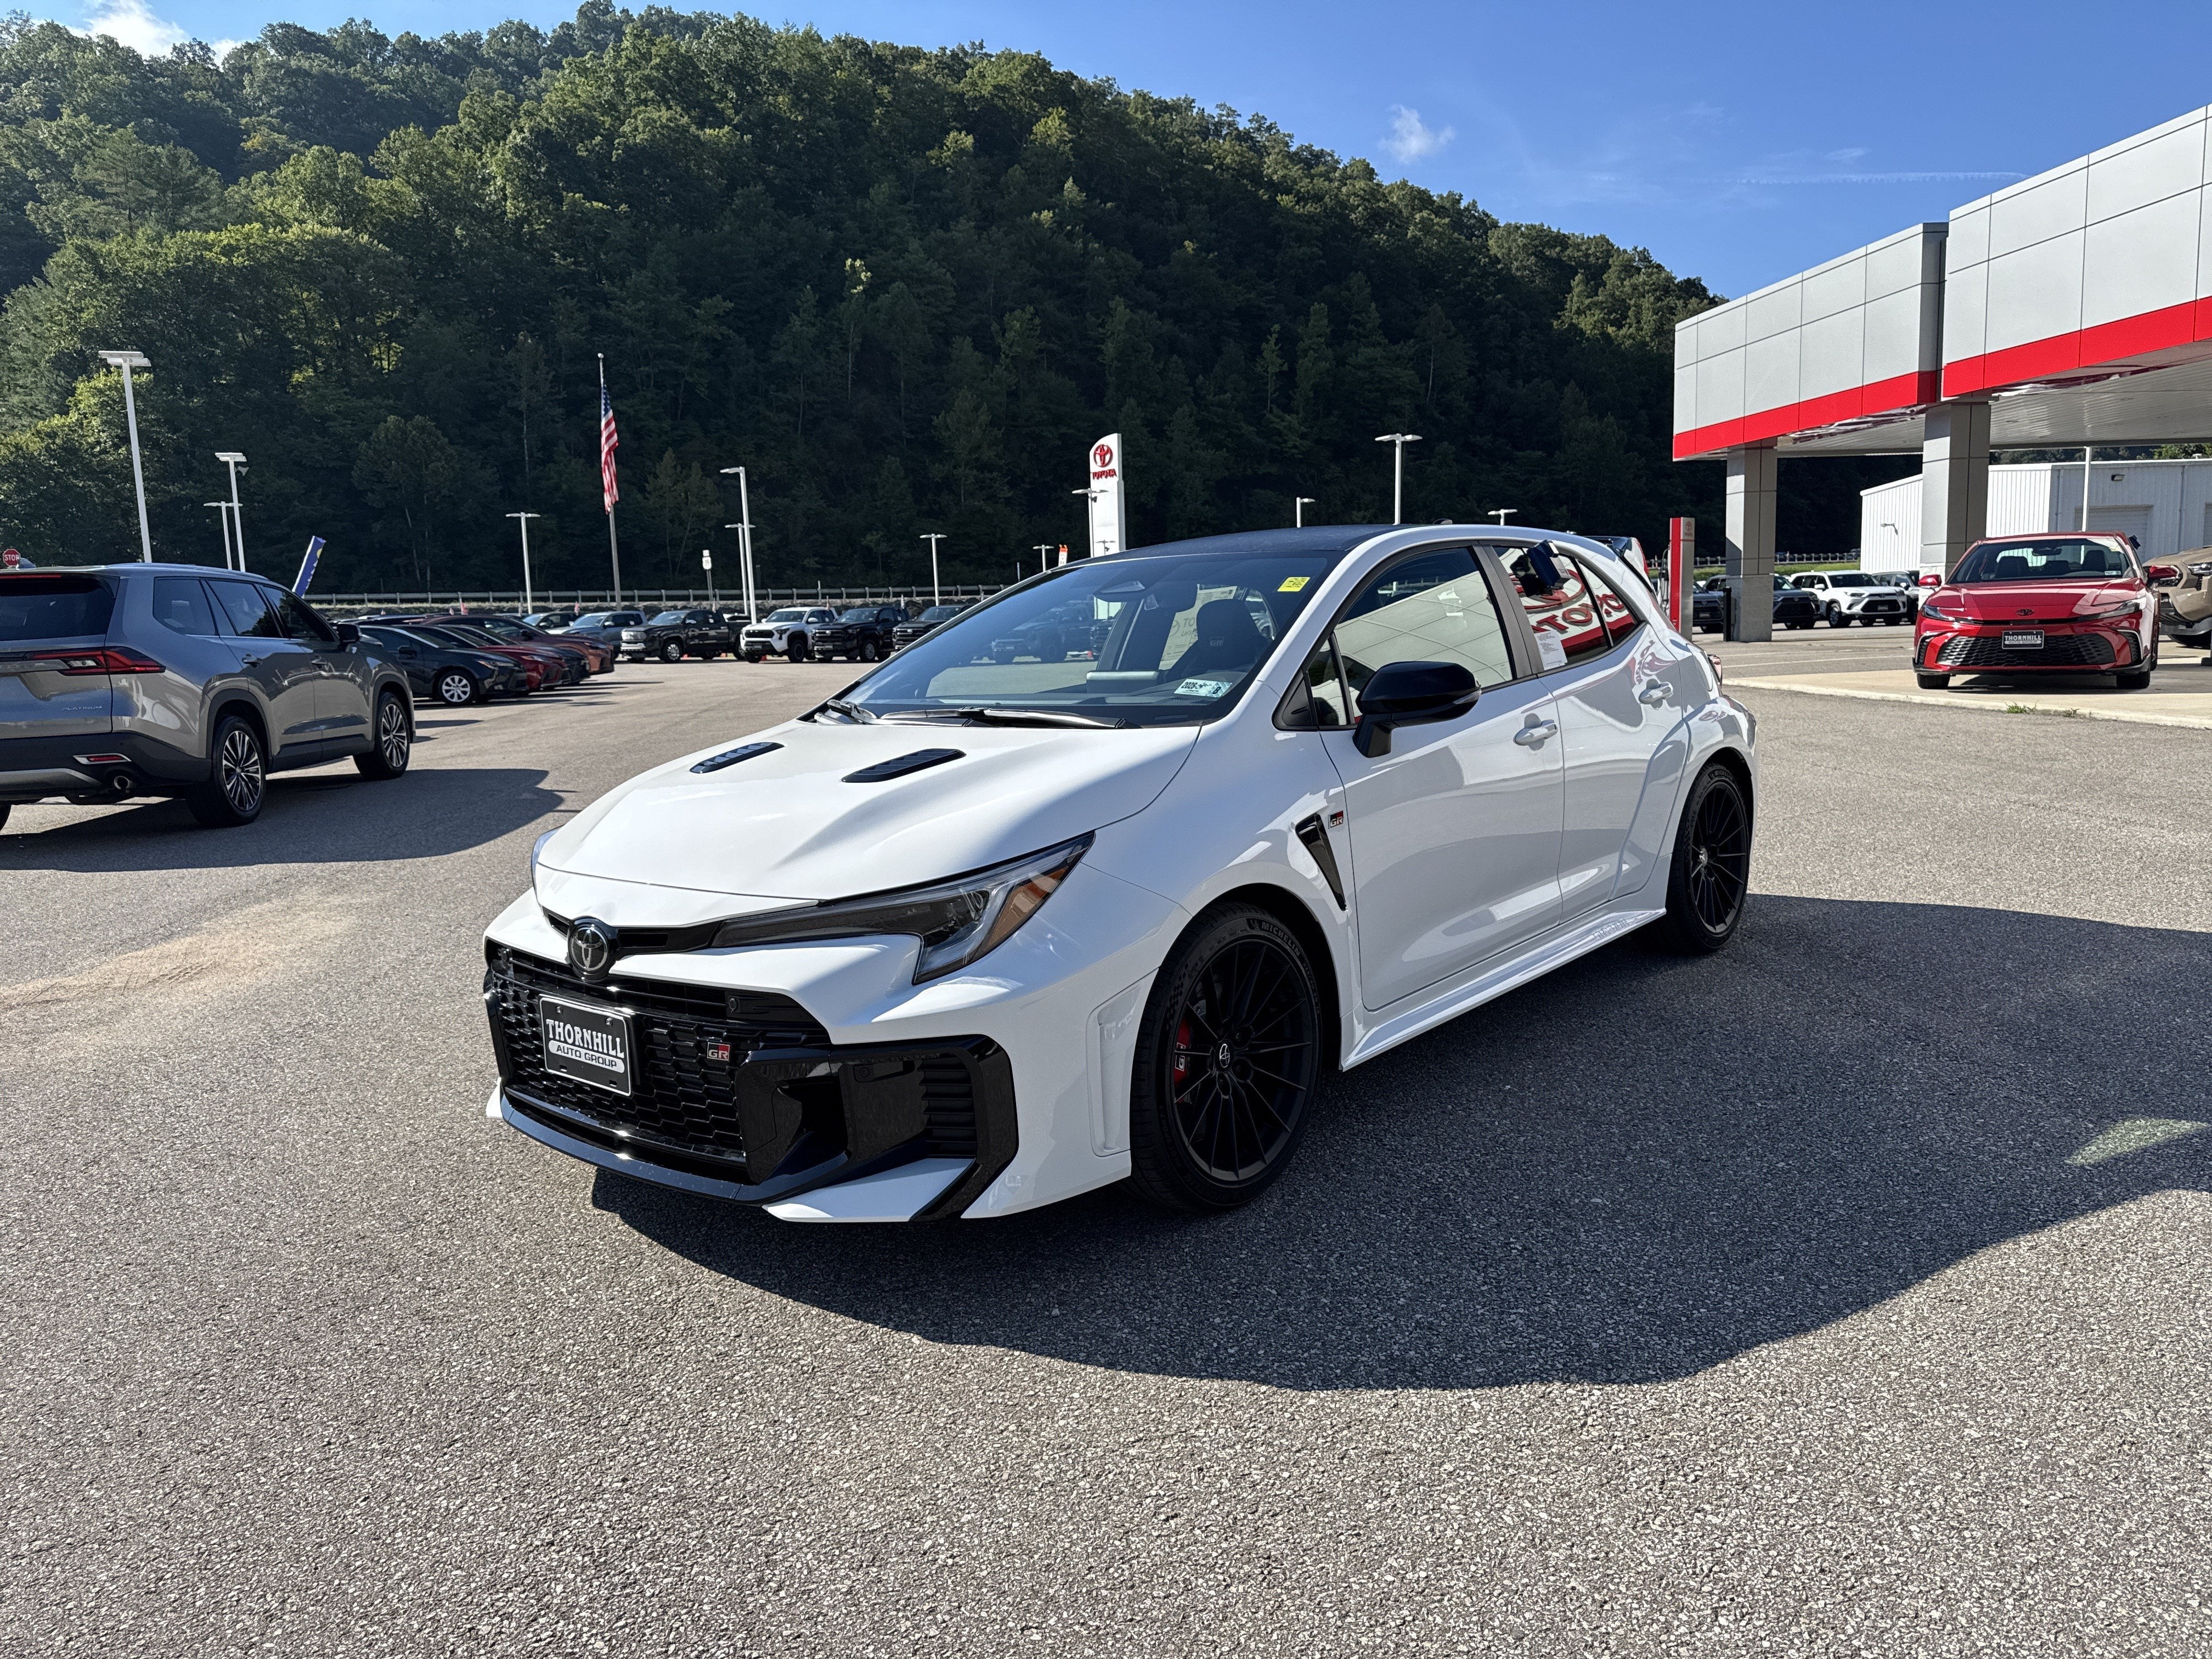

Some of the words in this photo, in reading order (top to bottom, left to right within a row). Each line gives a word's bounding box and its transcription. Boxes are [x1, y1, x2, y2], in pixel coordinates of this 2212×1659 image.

[1330, 816, 1343, 827] GR
[1261, 922, 1300, 956] MICHELIN
[546, 1019, 624, 1058] THORNHILL
[556, 1045, 582, 1058] AUTO
[584, 1052, 617, 1068] GROUP
[708, 1049, 729, 1059] GR
